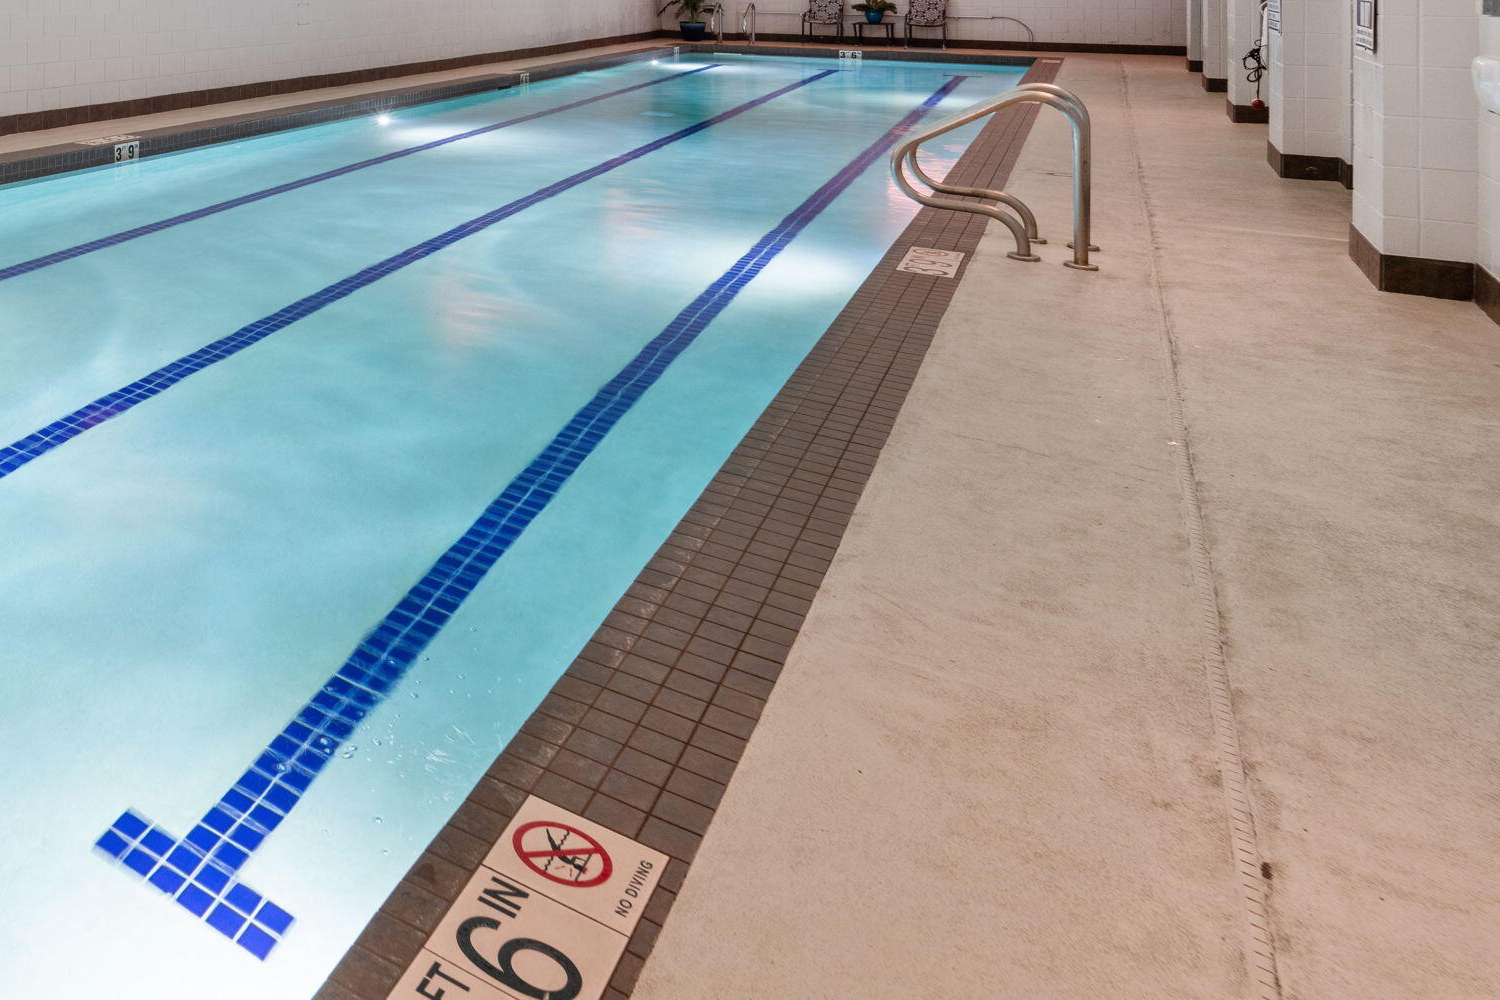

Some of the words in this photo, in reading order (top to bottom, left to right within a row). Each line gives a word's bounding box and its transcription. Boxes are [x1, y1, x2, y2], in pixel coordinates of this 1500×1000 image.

[116, 147, 122, 161] 3
[128, 145, 135, 159] 9
[477, 876, 530, 919] IN
[615, 898, 633, 918] NO
[628, 859, 654, 899] DIVING
[456, 916, 583, 1000] 6
[415, 961, 471, 1000] FT
